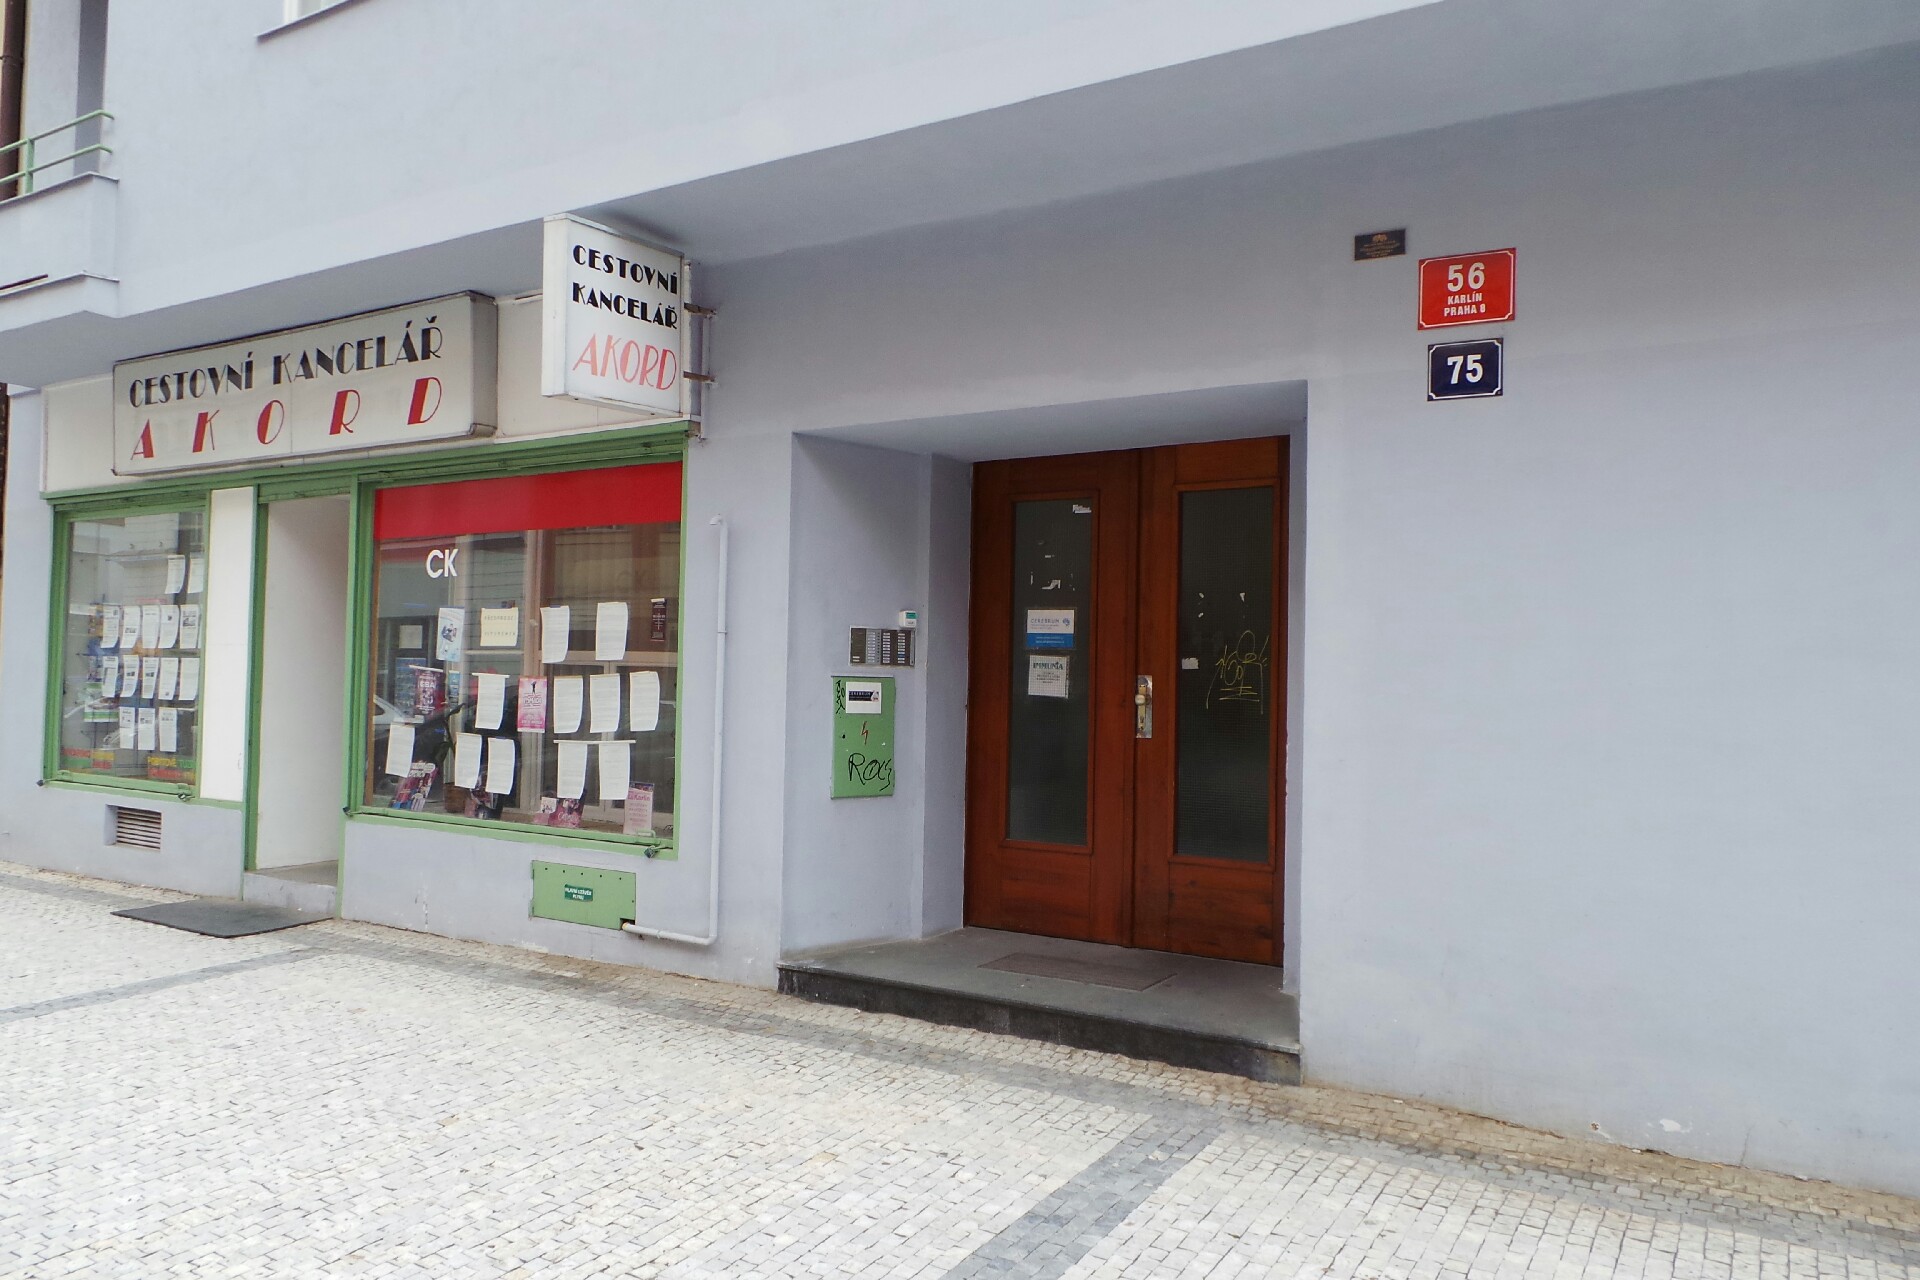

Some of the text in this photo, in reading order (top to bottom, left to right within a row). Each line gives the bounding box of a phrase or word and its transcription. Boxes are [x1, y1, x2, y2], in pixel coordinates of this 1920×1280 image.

[573, 244, 678, 295] CESTOVNÍ
[1447, 262, 1486, 292] 56
[572, 282, 678, 330] KANCELÁŘ
[1443, 303, 1486, 317] PRAHA 8
[1447, 291, 1483, 305] KARLÍN
[129, 316, 443, 408] CESTOVNÍ KANCELÁŘ
[572, 333, 677, 390] AKORD
[1447, 354, 1483, 385] 75
[130, 376, 443, 461] AKORD
[425, 549, 459, 579] CK
